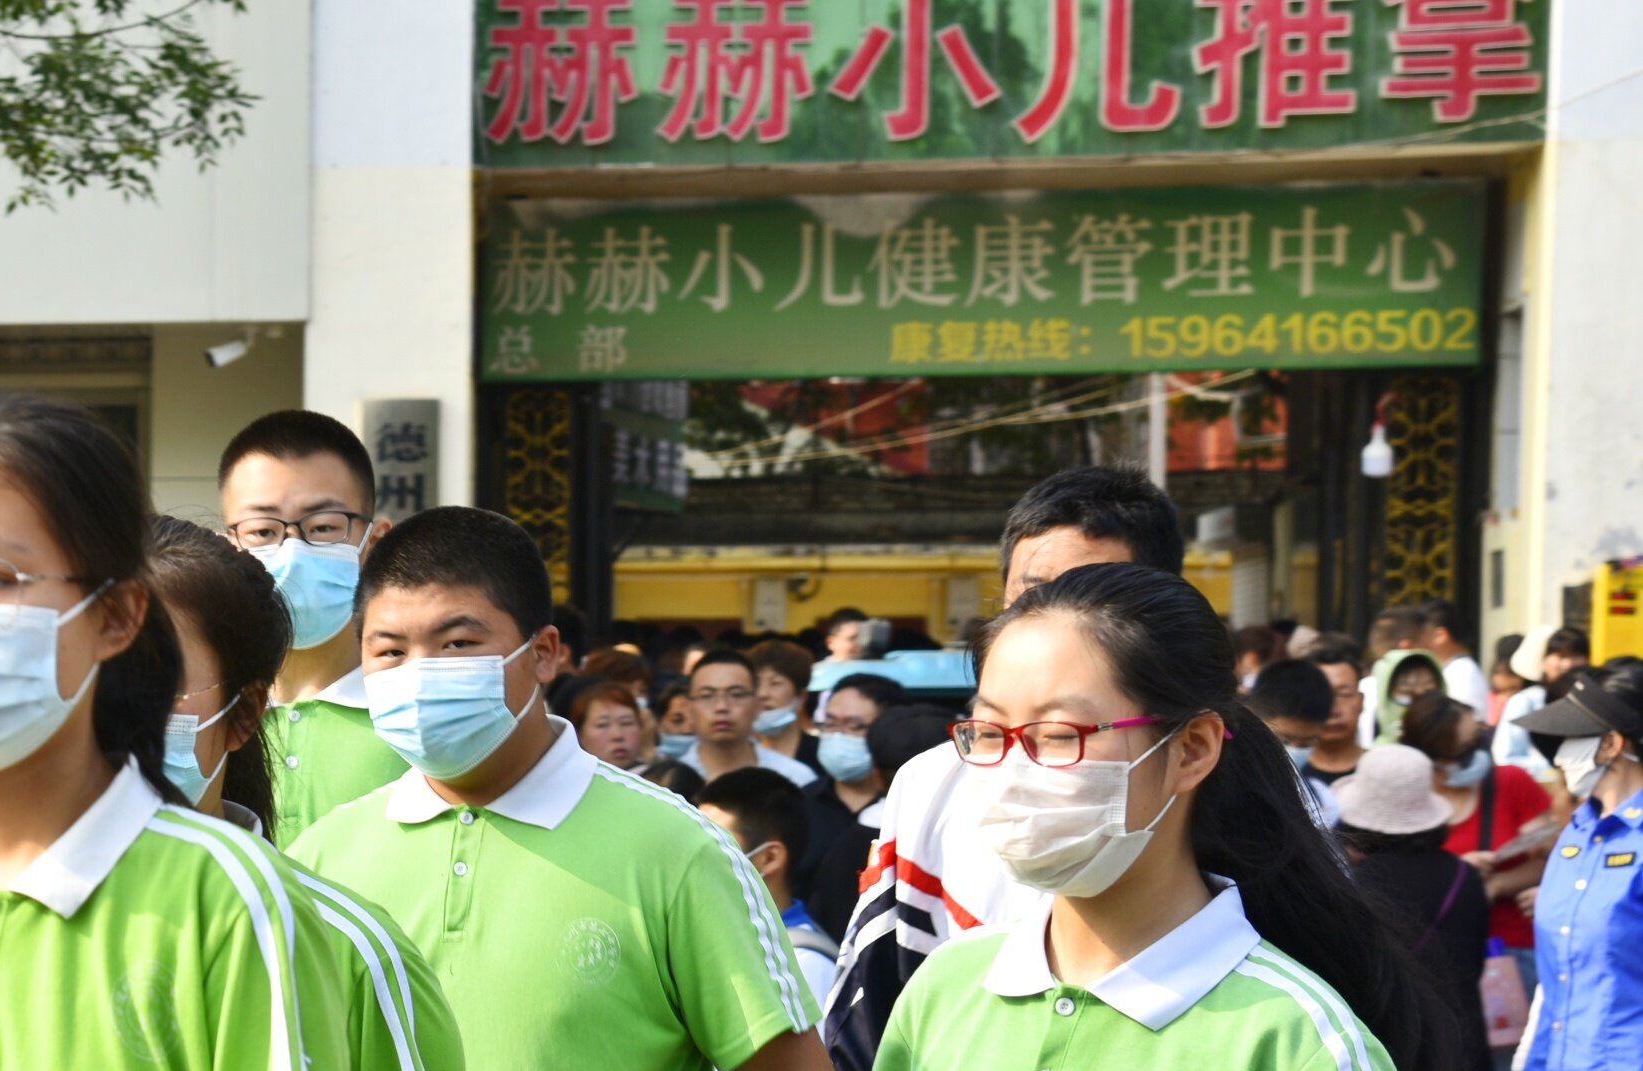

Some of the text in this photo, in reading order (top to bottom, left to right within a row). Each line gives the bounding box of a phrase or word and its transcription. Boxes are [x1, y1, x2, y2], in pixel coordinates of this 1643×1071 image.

[484, 0, 1542, 144] 赫赫小儿推拿
[491, 206, 1457, 316] 赫赫小儿健康管理中心
[1118, 307, 1478, 360] 15964166502
